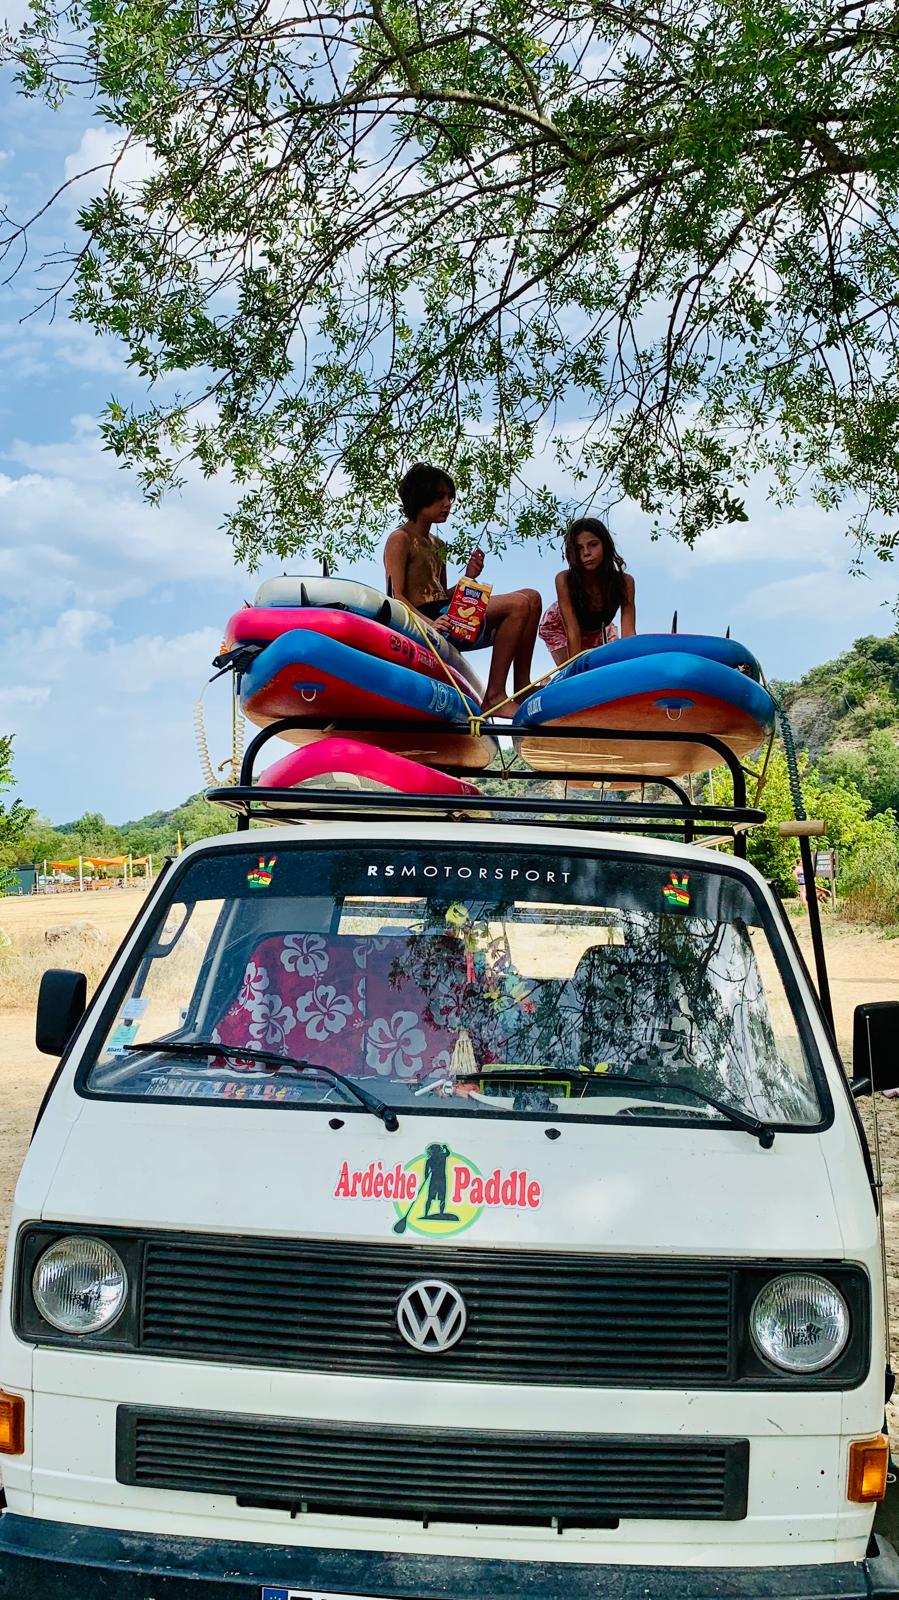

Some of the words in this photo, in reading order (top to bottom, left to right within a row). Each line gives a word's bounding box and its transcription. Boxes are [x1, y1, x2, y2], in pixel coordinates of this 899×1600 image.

[334, 1161, 417, 1200] Ardèche
[452, 1166, 541, 1208] Paddle
[398, 1282, 465, 1350] VW
